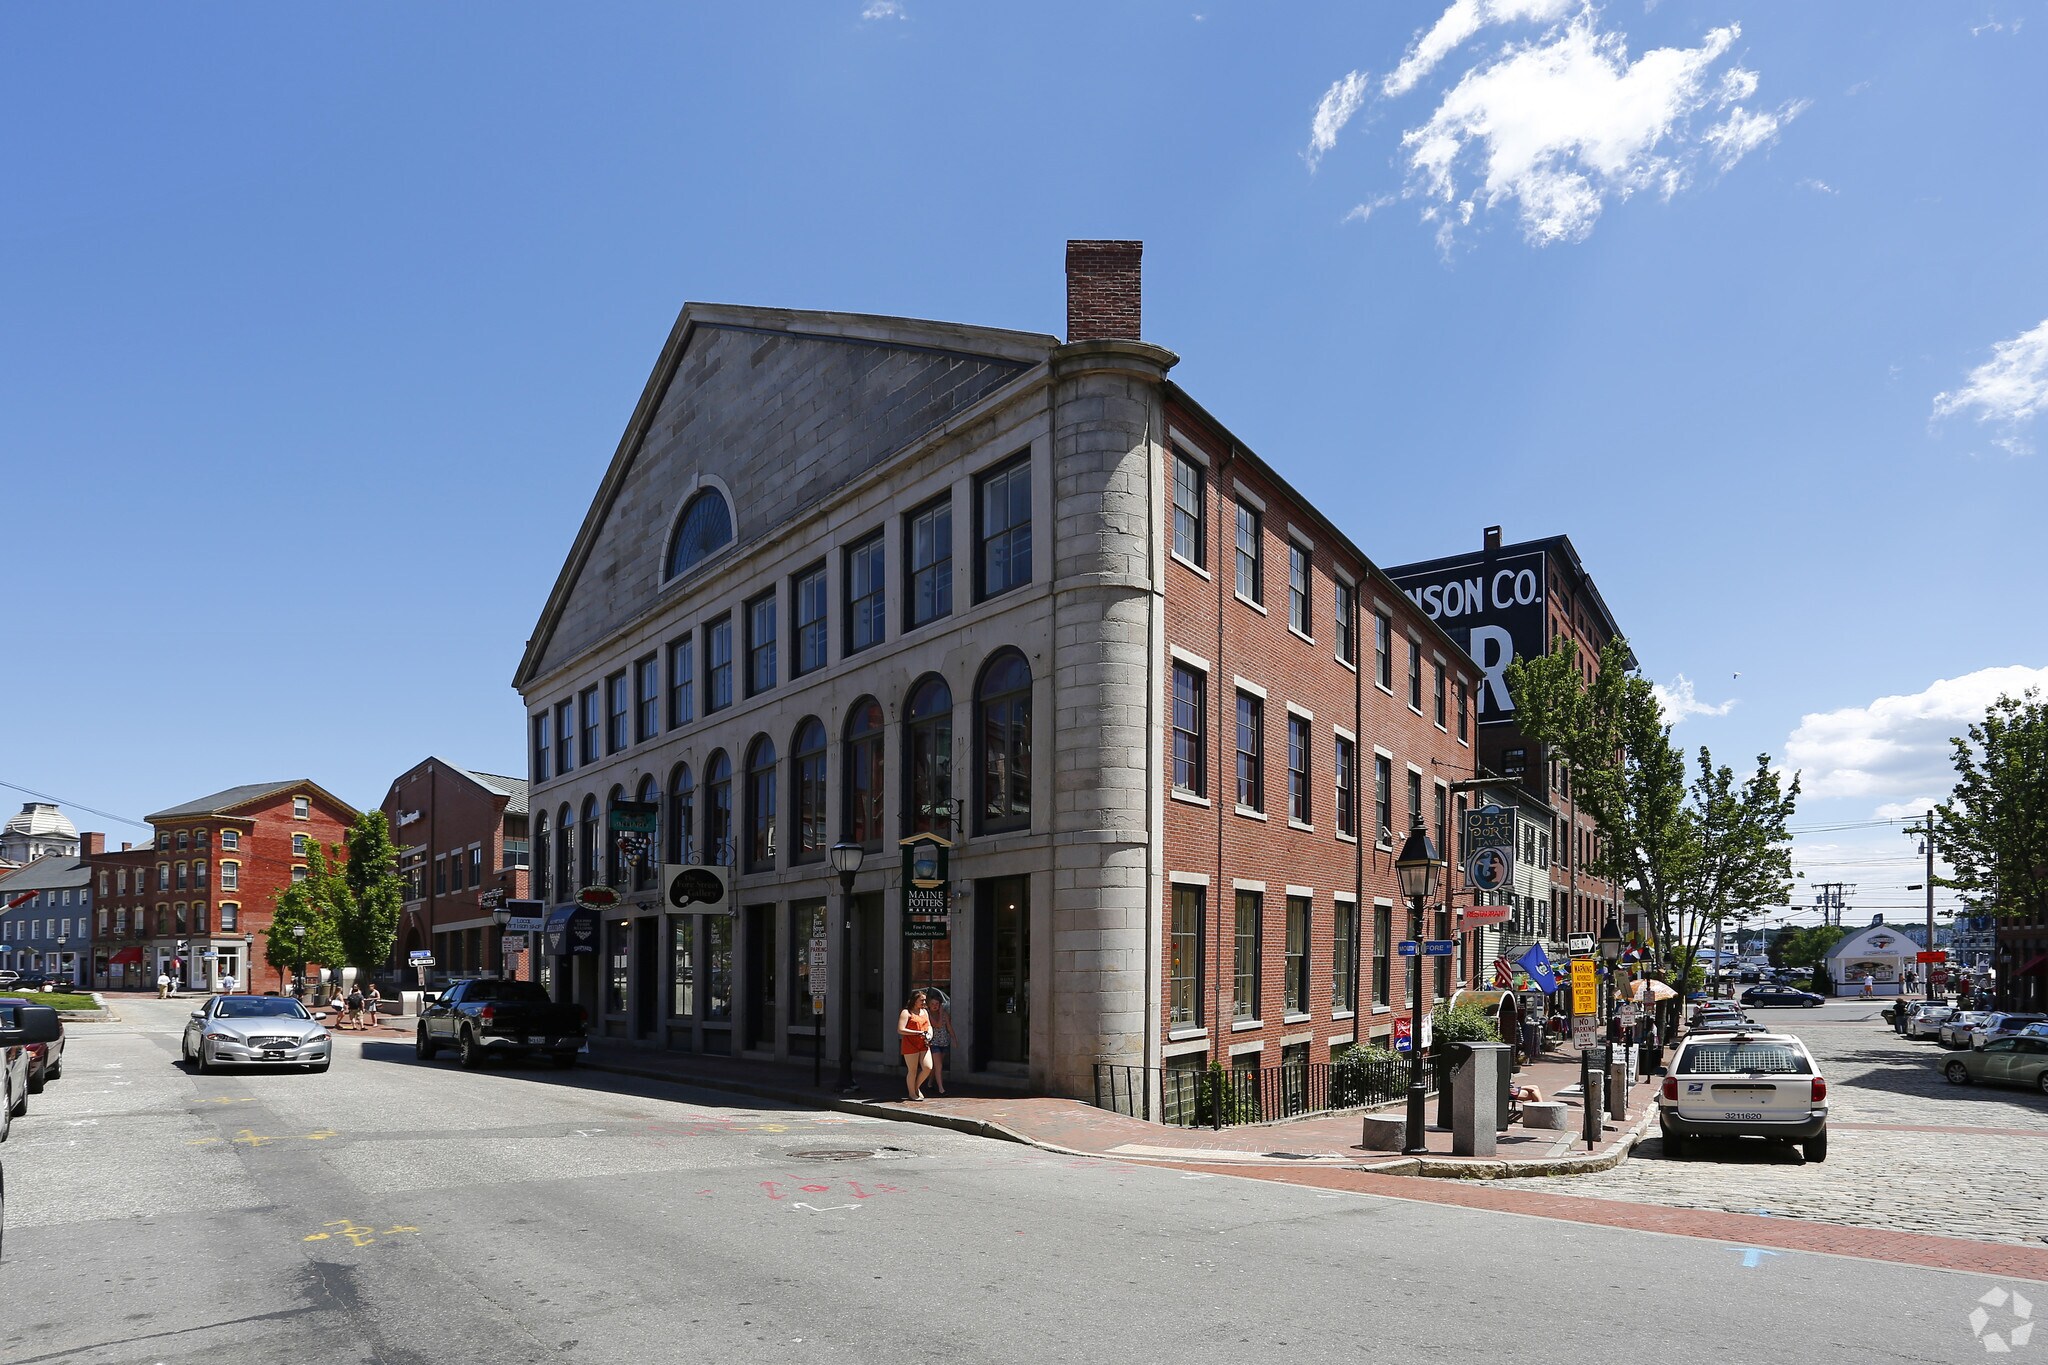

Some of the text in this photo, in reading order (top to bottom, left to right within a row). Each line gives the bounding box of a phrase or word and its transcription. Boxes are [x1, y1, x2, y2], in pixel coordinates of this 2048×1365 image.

[1404, 568, 1542, 621] NSON CO.
[1471, 624, 1516, 714] R
[1475, 837, 1512, 847] TAVERN
[908, 890, 944, 899] MAINE
[908, 899, 944, 907] POTTERS
[1467, 909, 1506, 918] RESTAURANT
[1574, 965, 1592, 974] WARNING
[1579, 1018, 1589, 1026] NO
[1725, 1112, 1762, 1120] 3211620
